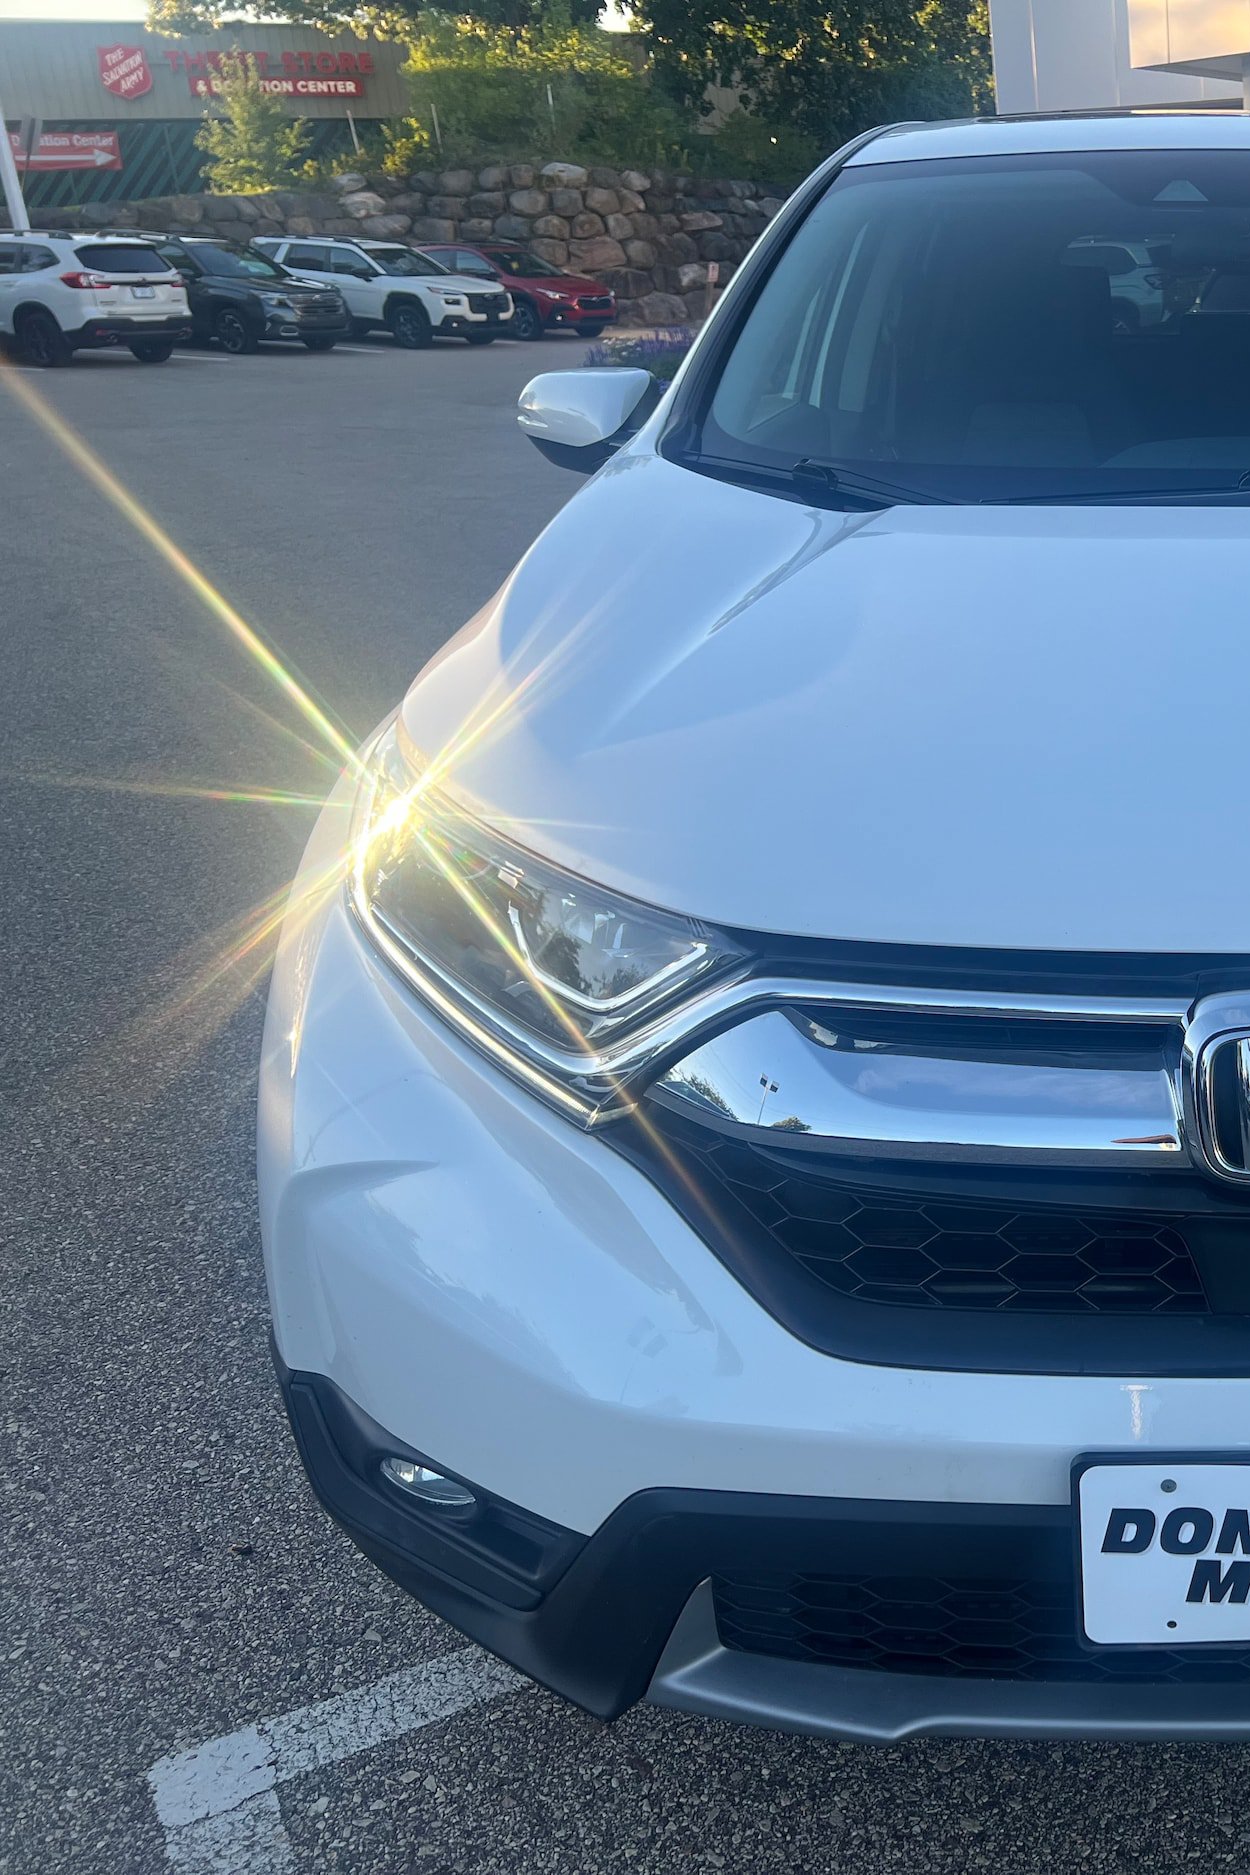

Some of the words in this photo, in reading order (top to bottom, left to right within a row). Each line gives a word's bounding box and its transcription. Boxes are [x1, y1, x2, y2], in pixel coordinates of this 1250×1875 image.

[105, 48, 124, 66] THE
[163, 51, 268, 73] THT
[281, 51, 375, 74] STORE
[121, 67, 144, 92] ARMY
[196, 80, 208, 95] &
[211, 80, 294, 94] DOTION
[296, 81, 356, 93] CENTER
[10, 134, 70, 146] Dation
[72, 134, 114, 146] Center
